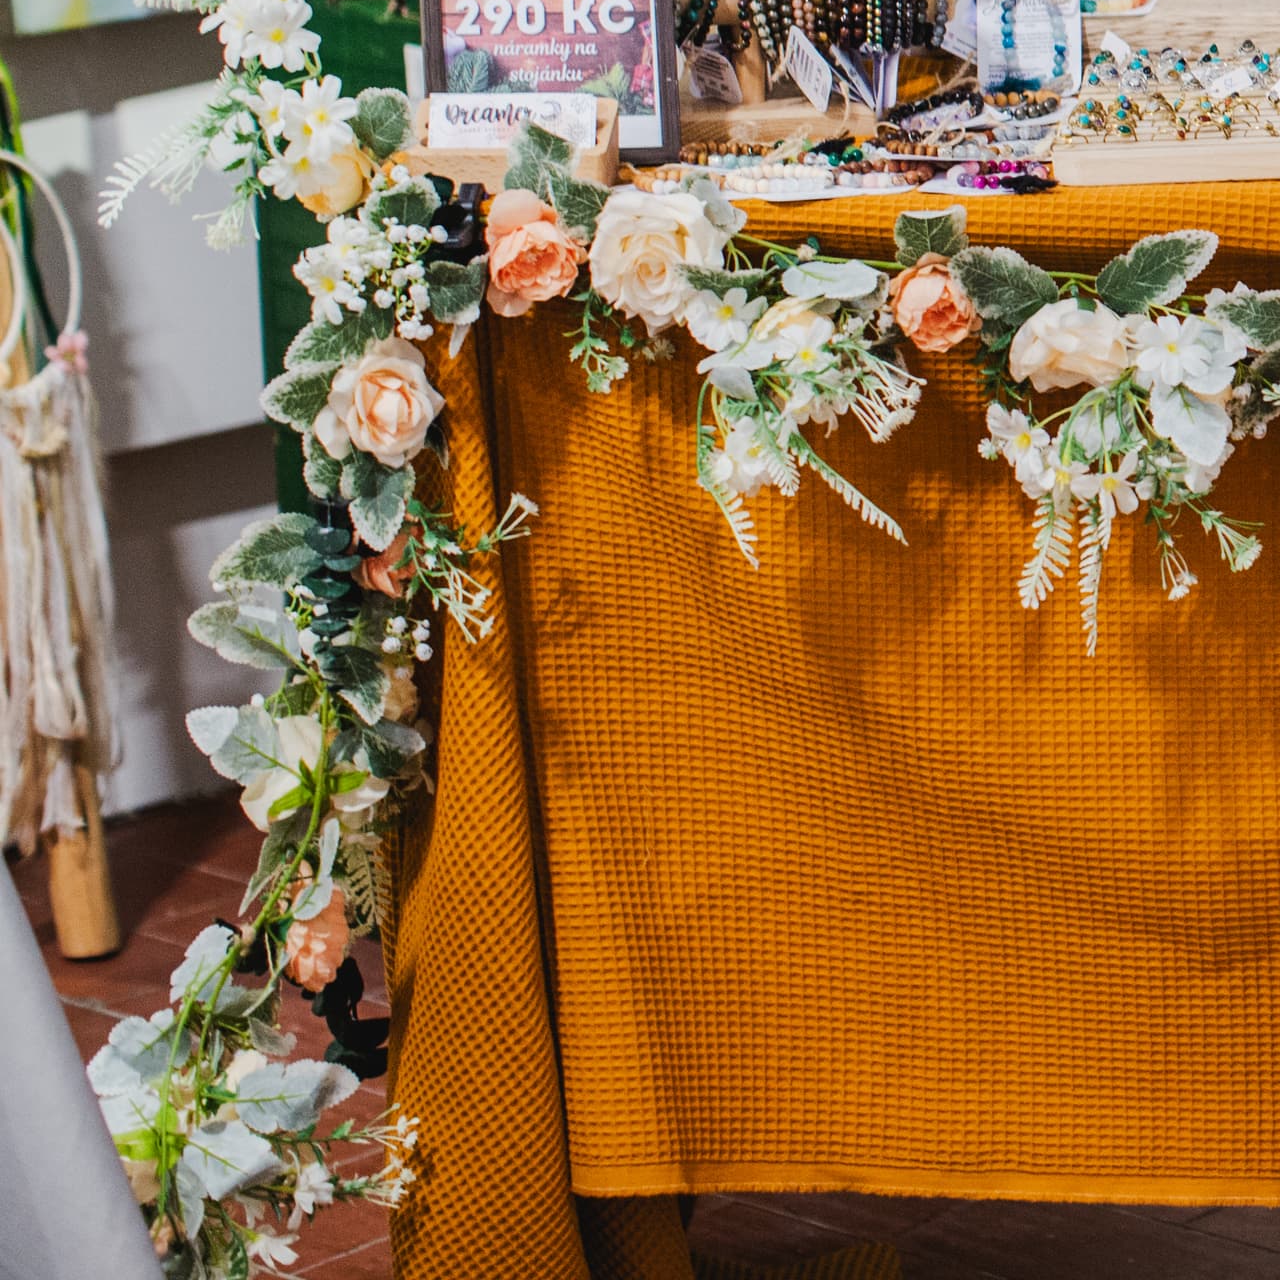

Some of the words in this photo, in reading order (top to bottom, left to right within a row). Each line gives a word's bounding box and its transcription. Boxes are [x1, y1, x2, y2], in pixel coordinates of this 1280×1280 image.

[493, 39, 571, 60] náramky
[574, 42, 598, 56] na
[508, 64, 584, 87] stojánku
[445, 103, 537, 126] Dreamer
